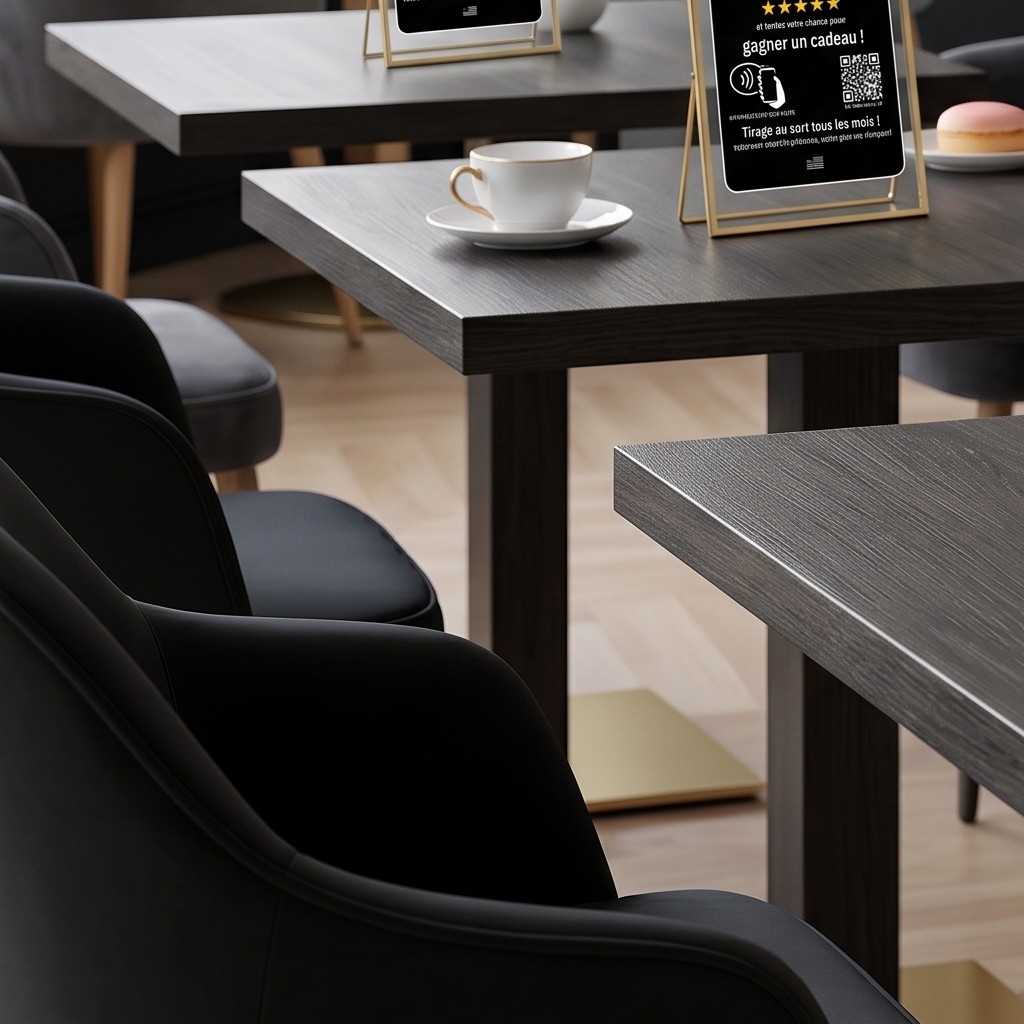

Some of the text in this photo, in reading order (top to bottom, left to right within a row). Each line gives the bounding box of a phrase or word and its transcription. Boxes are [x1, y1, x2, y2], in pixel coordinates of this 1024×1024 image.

[742, 28, 865, 58] gagner un cadeau !
[741, 125, 774, 140] Tirage
[775, 125, 788, 136] au
[789, 122, 810, 134] sort
[810, 121, 833, 132] tous
[834, 118, 850, 130] les
[851, 116, 875, 129] mois
[876, 114, 881, 127] !
